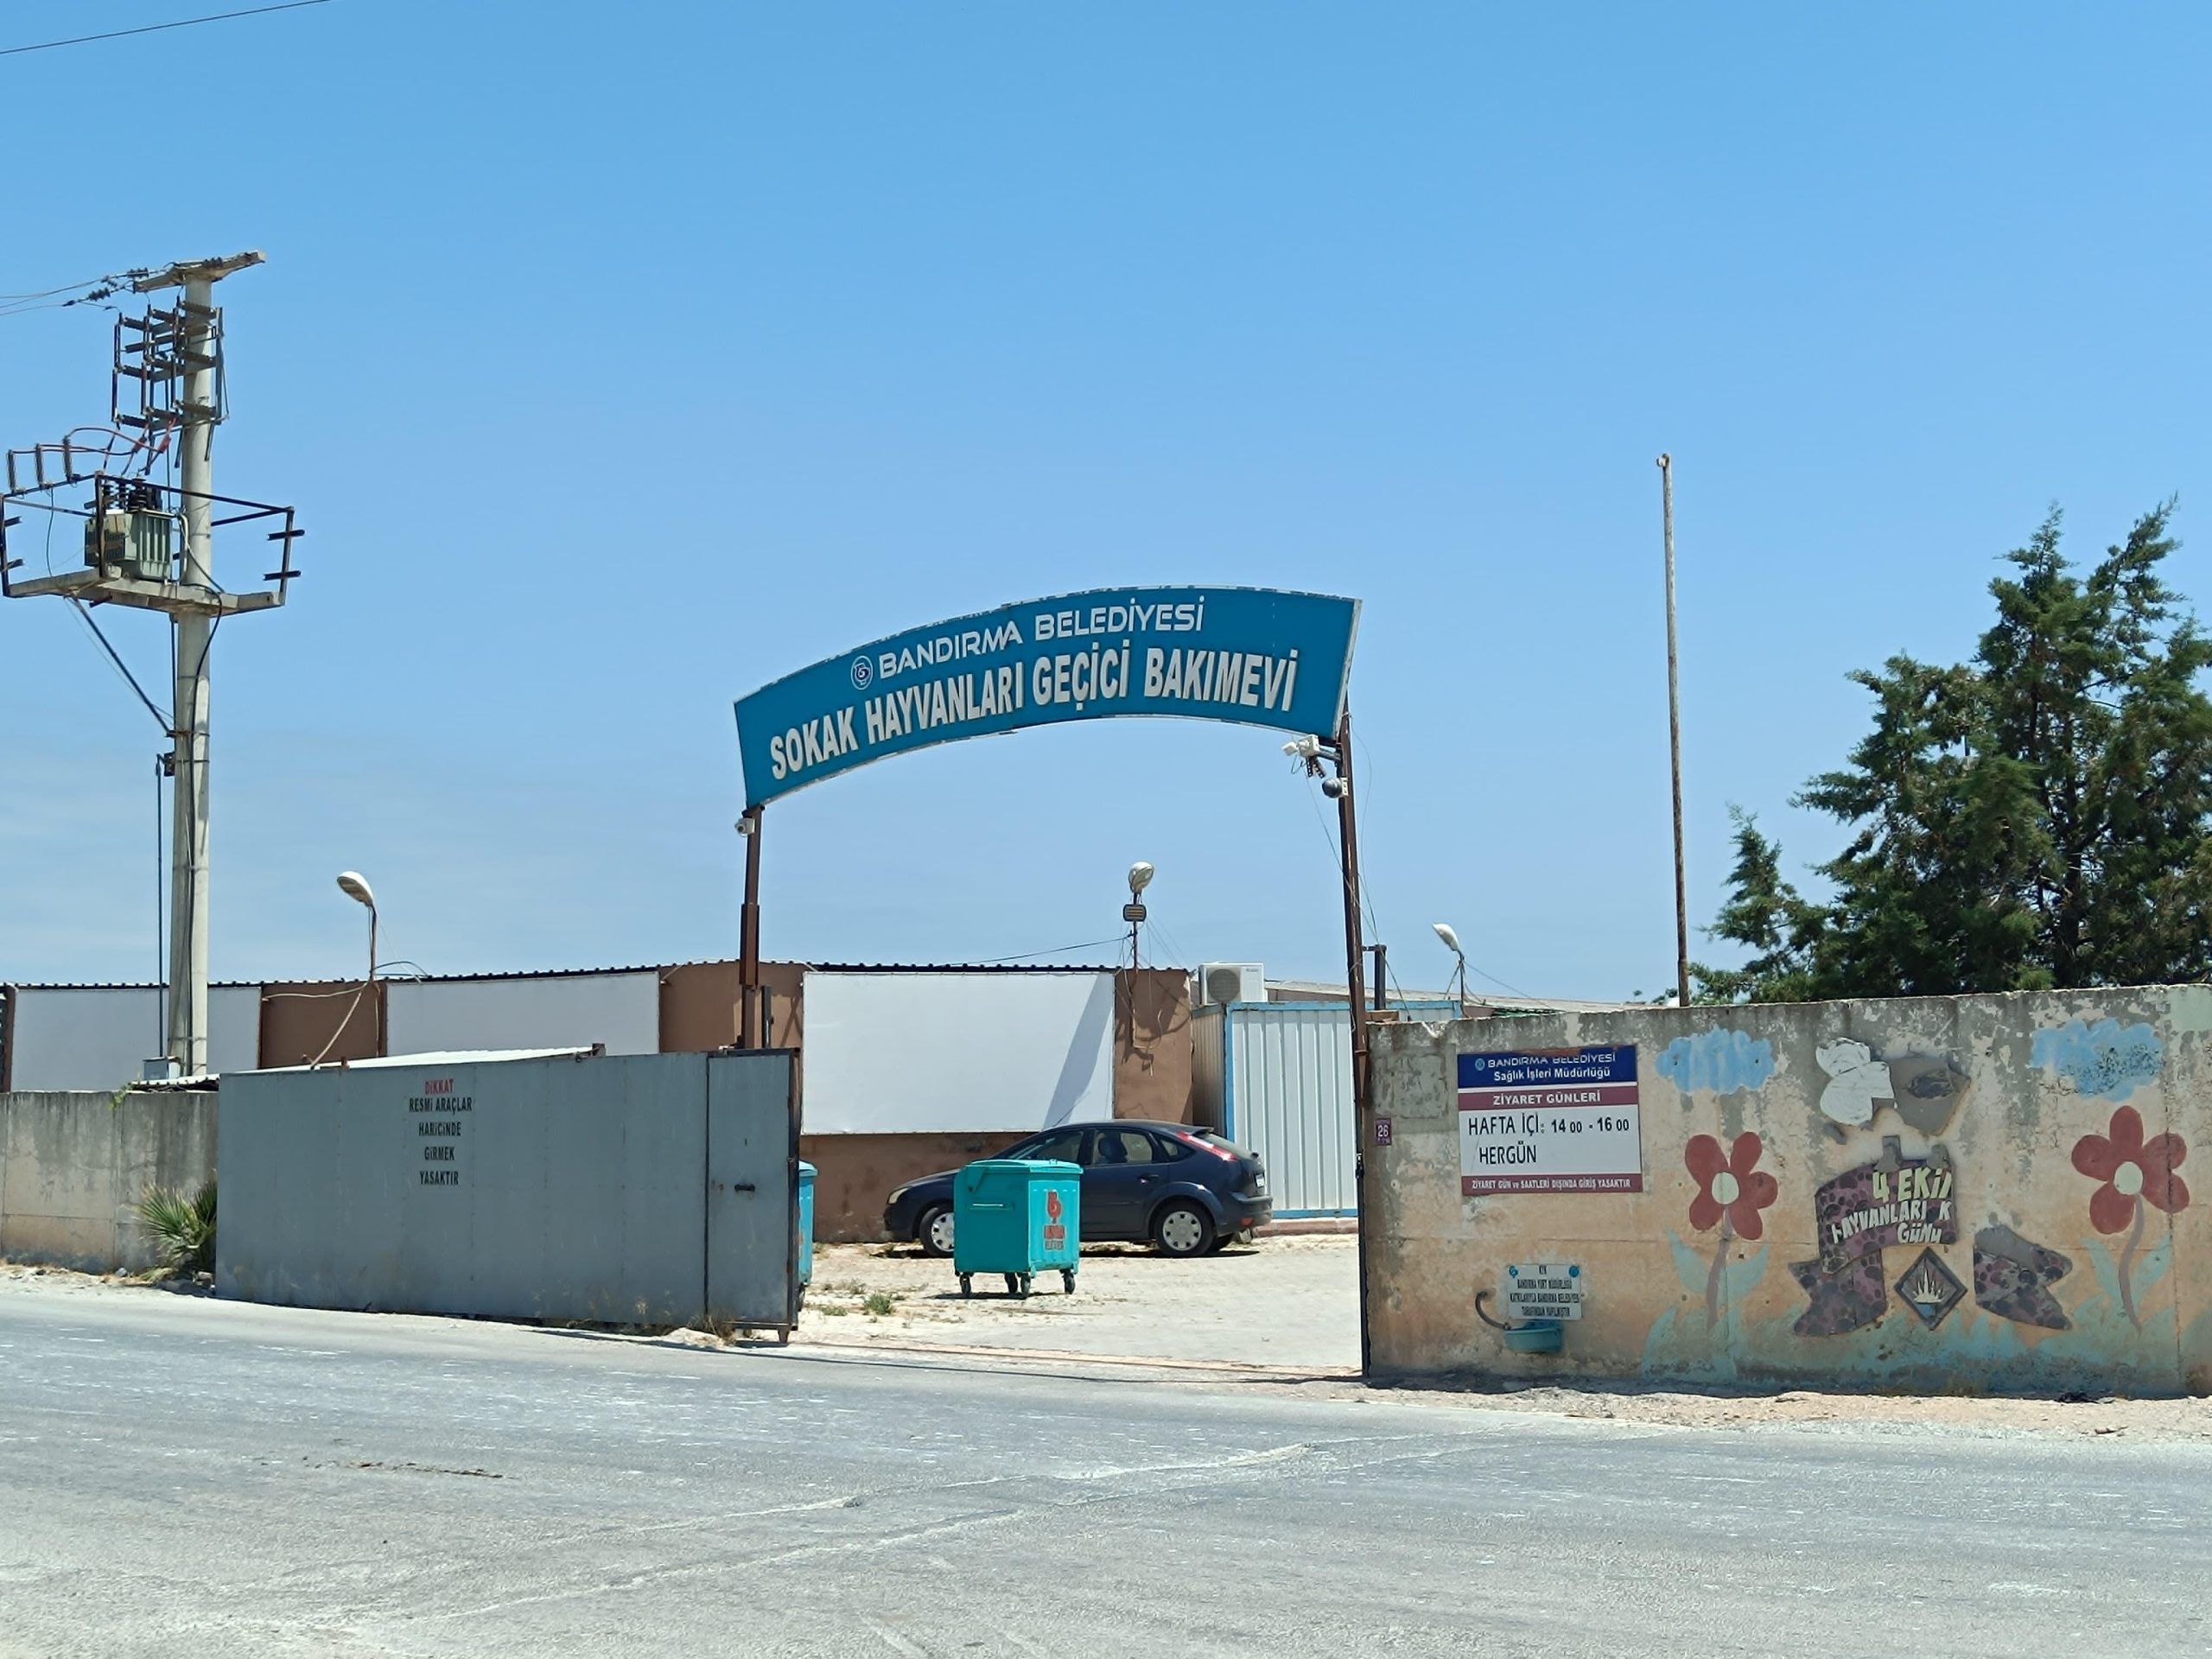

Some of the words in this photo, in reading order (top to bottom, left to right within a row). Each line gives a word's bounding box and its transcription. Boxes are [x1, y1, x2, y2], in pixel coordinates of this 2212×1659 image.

[879, 620, 1023, 679] BANDIRMA
[1035, 595, 1205, 641] BELEDİYESİ
[770, 706, 859, 780] SOKAK
[867, 661, 1024, 744] HAYVANLARI
[1033, 639, 1130, 711] GEÇİCİ
[1144, 648, 1299, 712] BAKIMEVİ
[1488, 1057, 1548, 1068] BANDIRMA
[1553, 1051, 1616, 1064] BELEDİYESİ
[1494, 1069, 1524, 1083] Sağlık
[1527, 1066, 1552, 1079] İşleri
[1554, 1066, 1611, 1080] Müdürlüğü
[435, 1096, 473, 1116] ARAÇLAR
[1493, 1092, 1543, 1105] ZİYARET
[1547, 1090, 1601, 1103] GÜNLERİ
[418, 1122, 461, 1136] HARİCİNDE
[1377, 1124, 1389, 1137] 26
[1469, 1116, 1516, 1135] HAFTA
[1551, 1118, 1566, 1133] 14
[1569, 1122, 1582, 1133] 00
[1597, 1117, 1612, 1132] 16
[1617, 1119, 1630, 1131] 00
[424, 1146, 455, 1160] GİRMEK
[1478, 1141, 1537, 1165] HERGÜN
[419, 1171, 459, 1185] YASAKTIR
[1472, 1179, 1496, 1189] ZİYARET
[1498, 1179, 1511, 1189] GÜN
[1521, 1179, 1549, 1189] SAATLERİ
[1597, 1179, 1631, 1189] YASAKTIR
[1872, 1171, 1890, 1204] 4
